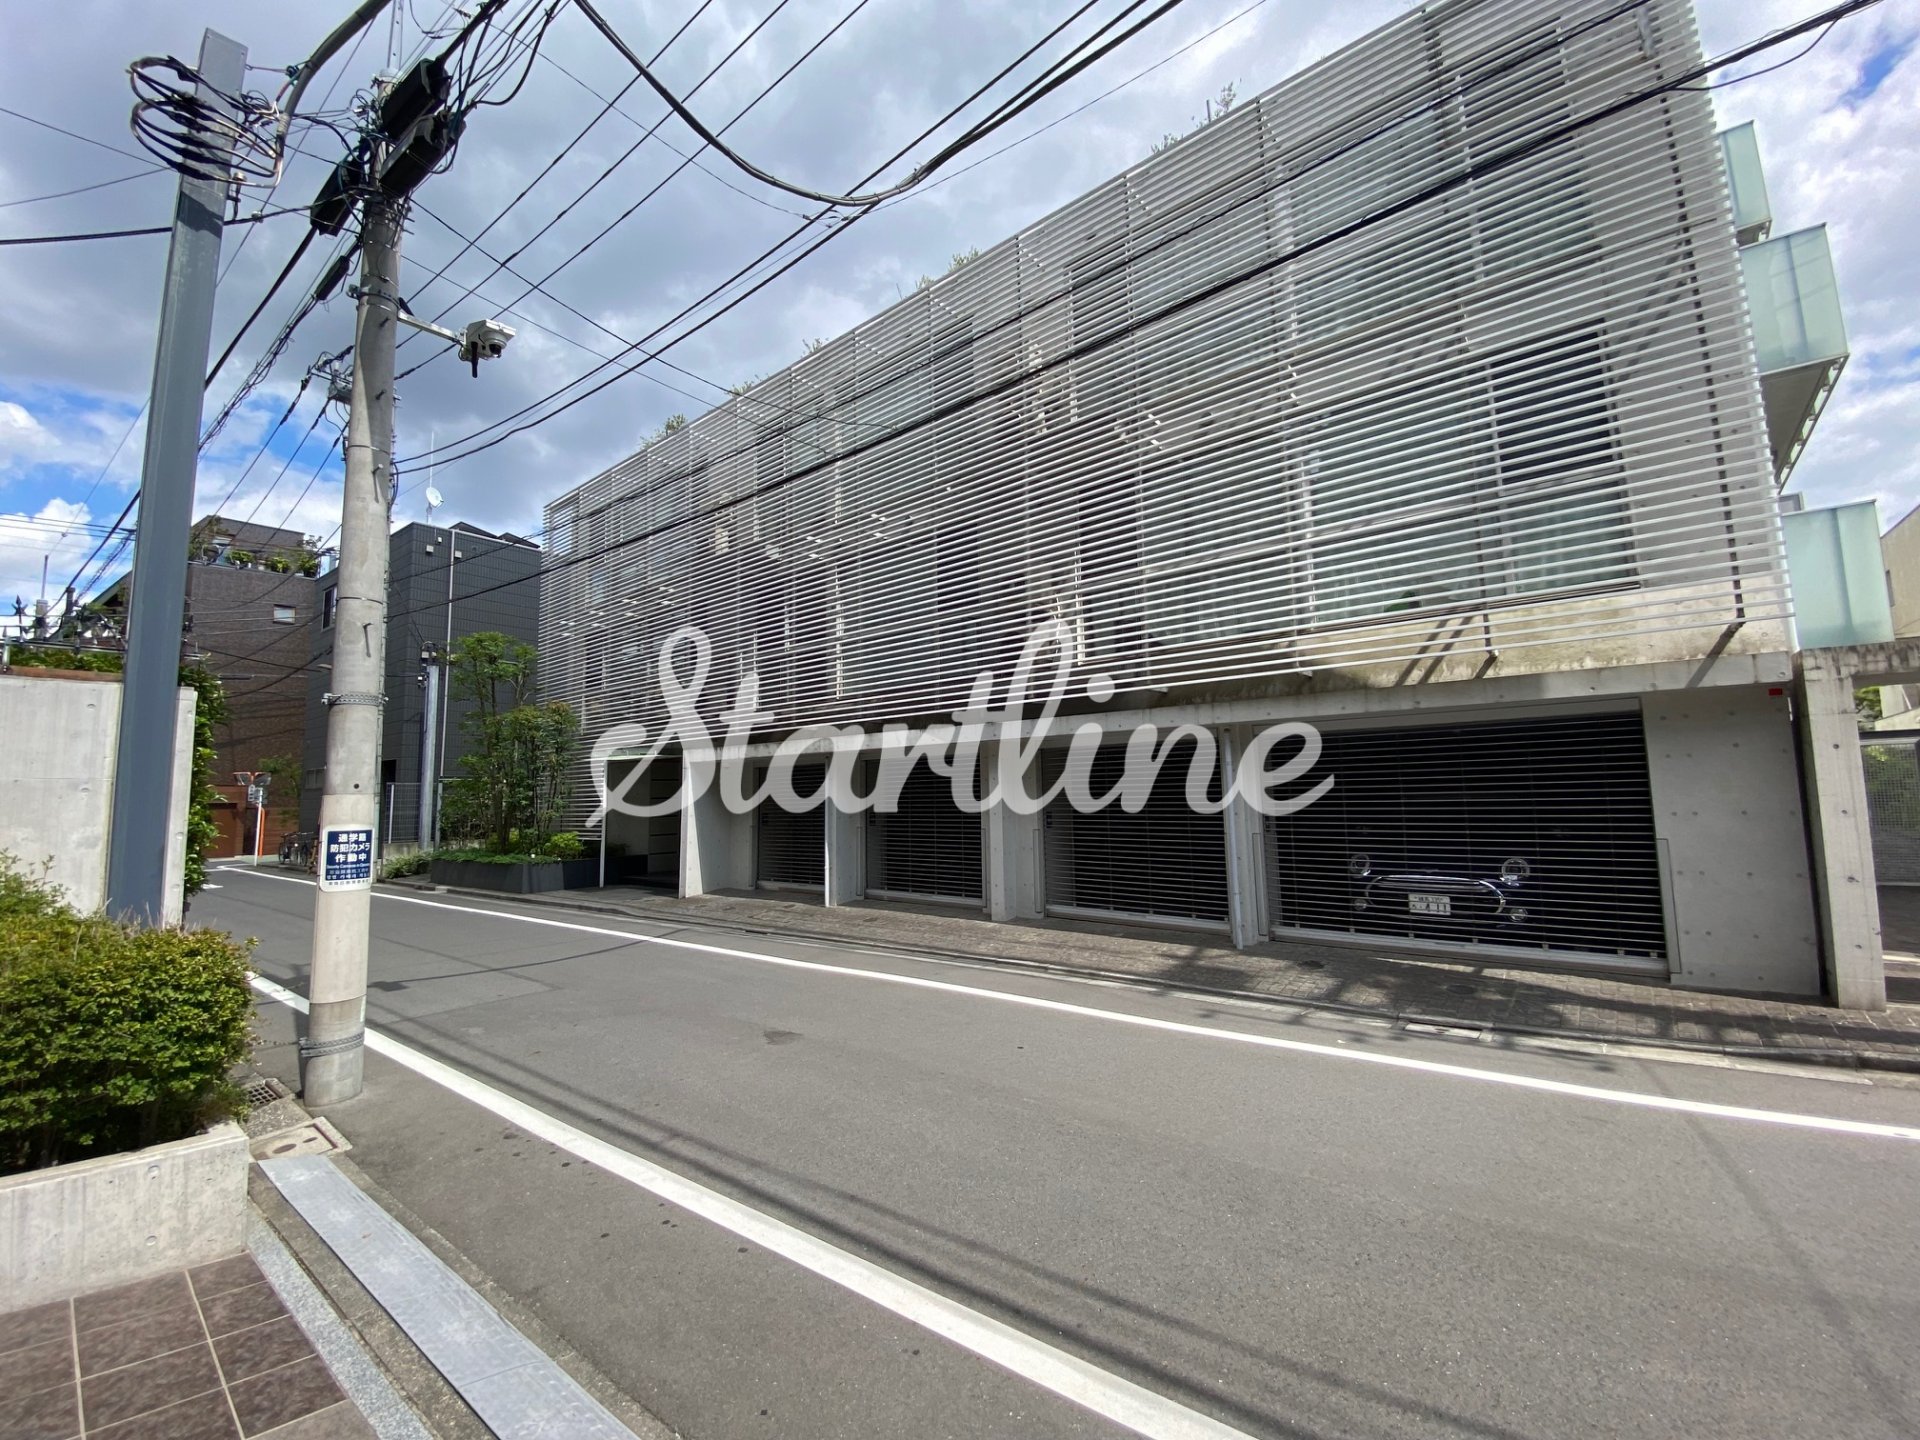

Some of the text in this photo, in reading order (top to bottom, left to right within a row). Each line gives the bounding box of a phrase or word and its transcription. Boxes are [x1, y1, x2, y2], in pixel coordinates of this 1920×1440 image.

[330, 843, 370, 853] 防犯カメラ
[335, 853, 367, 863] 作動中
